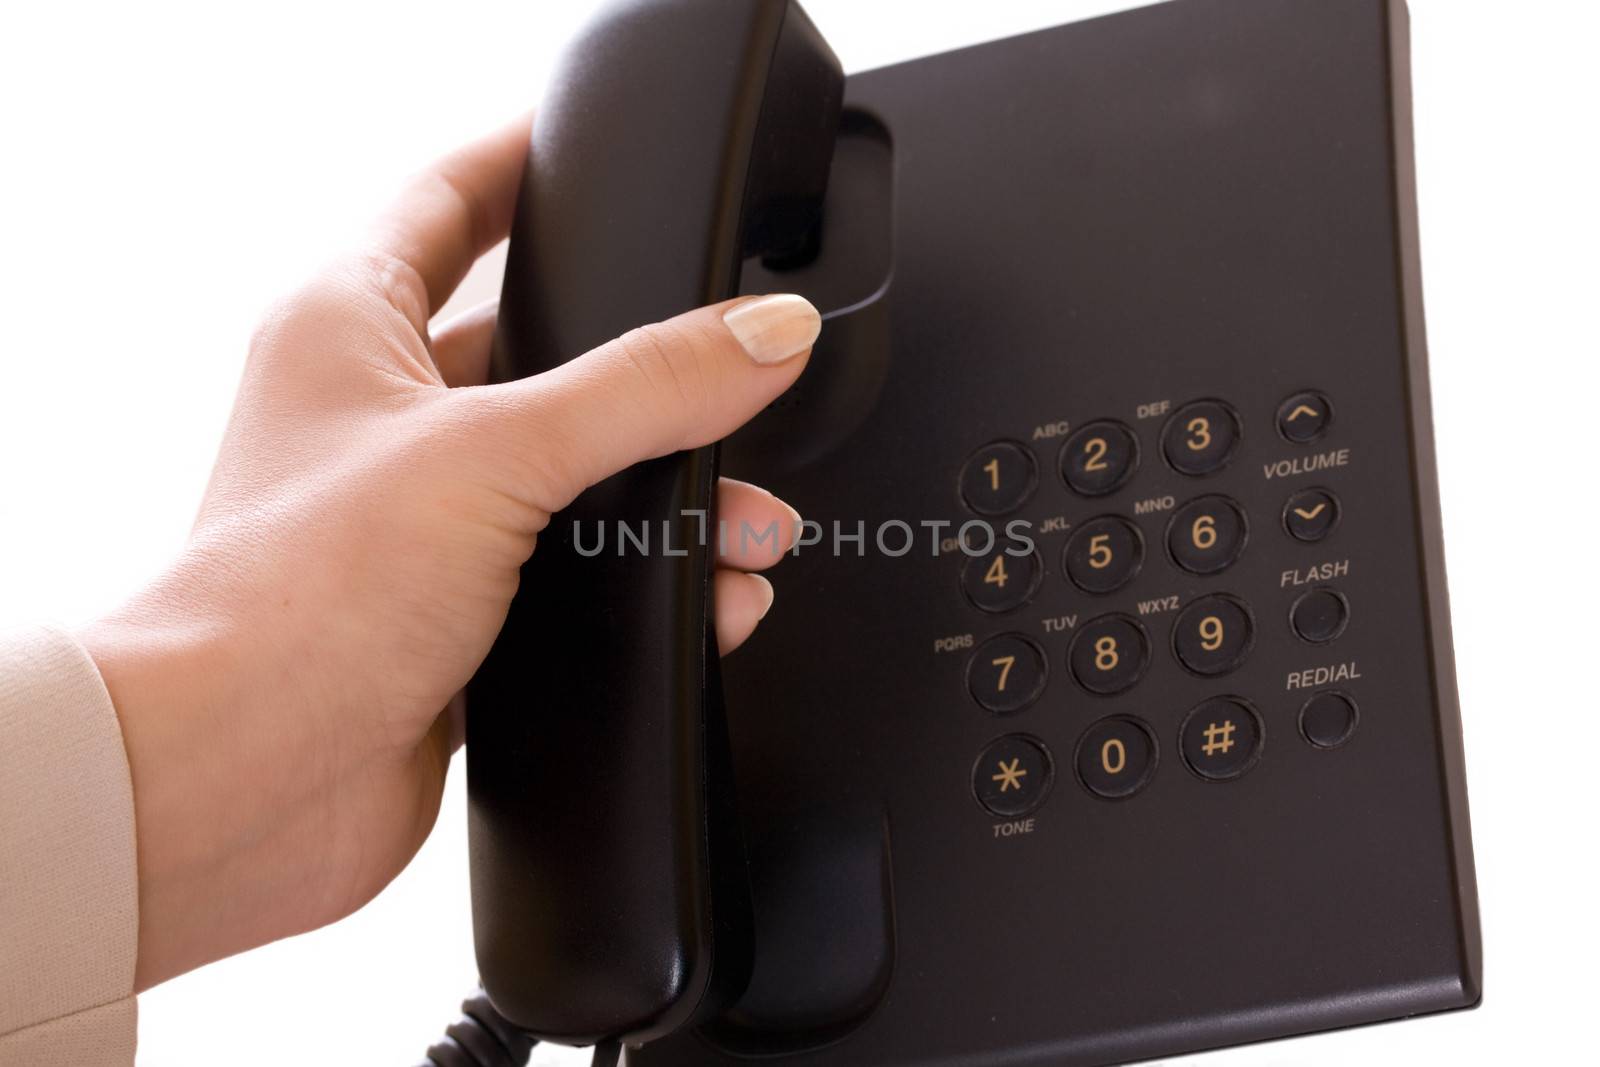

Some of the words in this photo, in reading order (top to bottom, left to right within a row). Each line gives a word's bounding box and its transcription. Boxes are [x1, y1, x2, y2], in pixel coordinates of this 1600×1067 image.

[1136, 400, 1170, 419] DEF
[1033, 421, 1070, 440] ABC
[1186, 417, 1211, 451] 3
[1084, 438, 1108, 472] 2
[1263, 449, 1349, 480] VOLUME
[983, 459, 999, 491] 1
[1134, 496, 1175, 515] MNO
[1039, 517, 1071, 534] JKL
[1191, 515, 1217, 549] 6
[1088, 534, 1113, 569] 5
[984, 554, 1009, 587] 4
[1280, 560, 1349, 588] FLASH
[1137, 596, 1179, 615] WXYZ
[1042, 615, 1078, 633] TUV
[1199, 616, 1224, 651] 9
[934, 633, 975, 654] PQRS
[1094, 636, 1119, 671] 8
[992, 655, 1016, 691] 7
[1286, 662, 1361, 690] REDIAL
[1201, 720, 1236, 756] #
[1101, 738, 1126, 774] 0
[993, 818, 1035, 838] TONE
